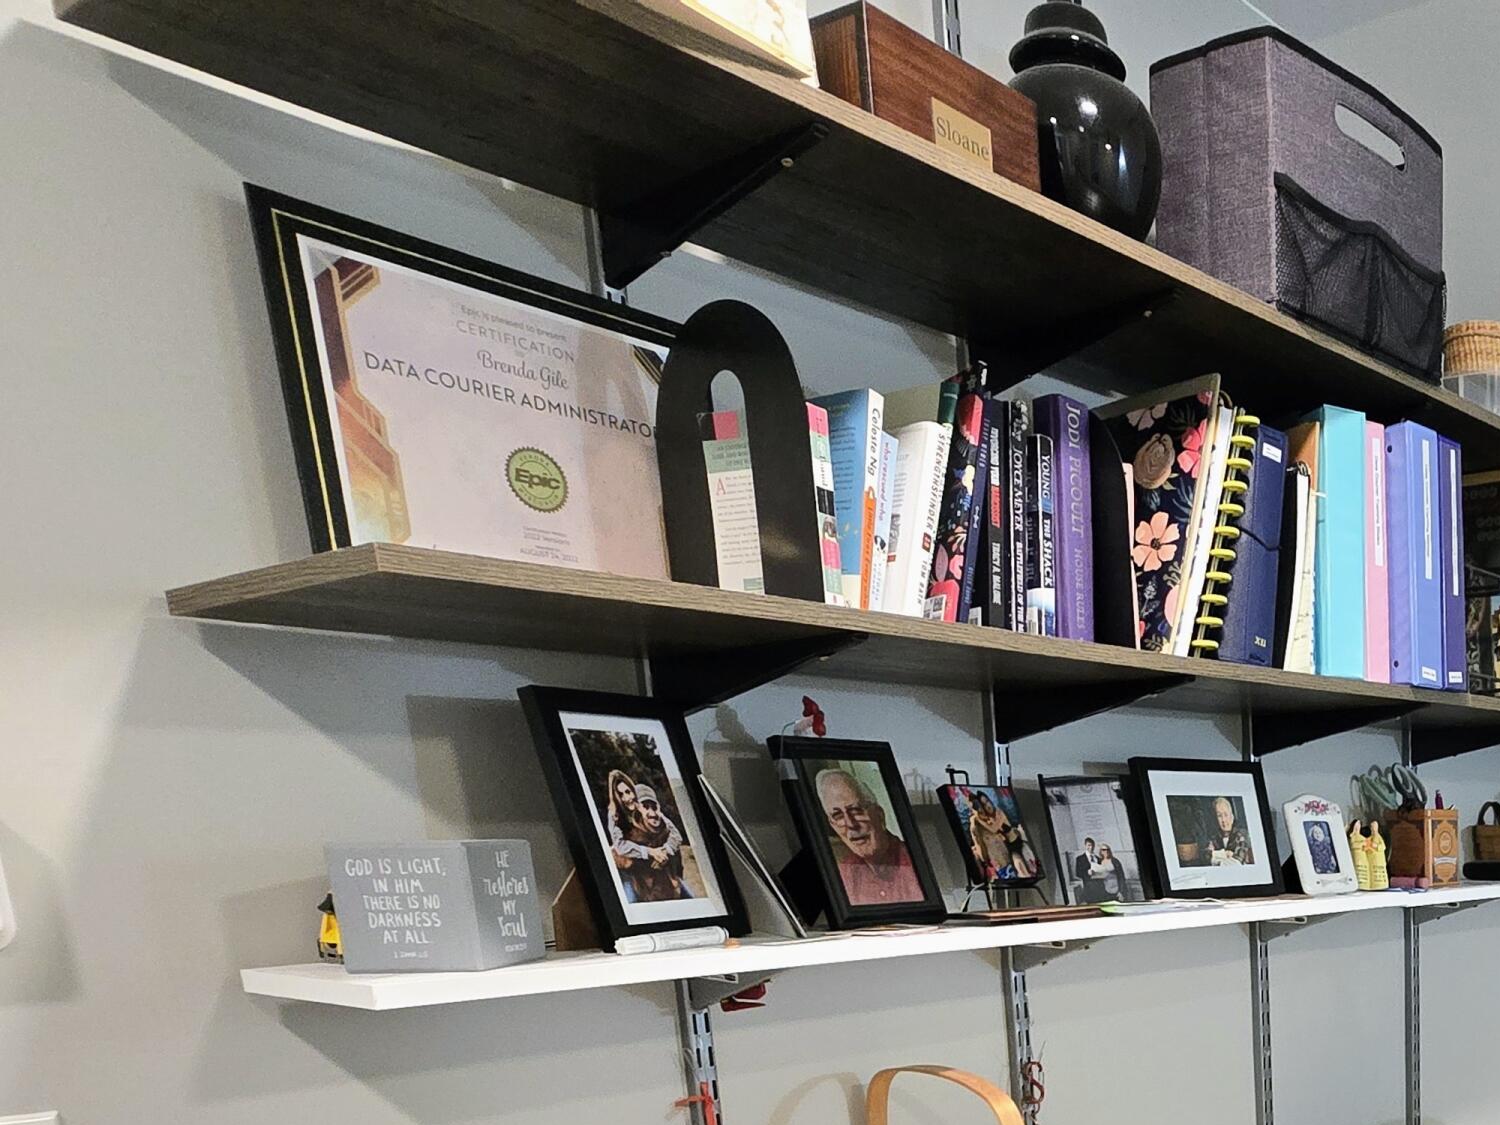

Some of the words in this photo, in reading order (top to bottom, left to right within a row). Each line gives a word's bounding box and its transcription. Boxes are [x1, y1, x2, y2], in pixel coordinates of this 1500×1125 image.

[936, 116, 989, 161] Sloane
[456, 320, 575, 362] CERTIFICATION
[364, 352, 420, 381] DATA
[425, 368, 515, 403] COURIER
[477, 350, 538, 381] Brenda
[870, 407, 882, 453] Celeste
[1066, 402, 1081, 448] JODI
[515, 467, 561, 490] Epic
[867, 457, 878, 476] Ng
[926, 433, 945, 532] STRENGTHSFINDER
[1012, 446, 1024, 485] JOYCE
[1040, 455, 1050, 499] YOUNG
[1014, 487, 1024, 531] MEYER
[1069, 455, 1084, 539] PICOULT
[1043, 539, 1053, 588] SHACK
[1075, 546, 1084, 590] HOUSE
[1075, 592, 1085, 633] RULES
[345, 858, 373, 877] GOD
[378, 859, 392, 875] IS
[495, 851, 510, 868] HE
[363, 894, 403, 911] THERE
[408, 895, 419, 909] IS
[423, 894, 440, 909] NO
[372, 878, 388, 894] IN
[394, 879, 424, 894] HIM
[367, 911, 442, 929] DARKNESS
[503, 900, 517, 916] MY
[383, 930, 398, 945] AT
[405, 929, 430, 944] ALL
